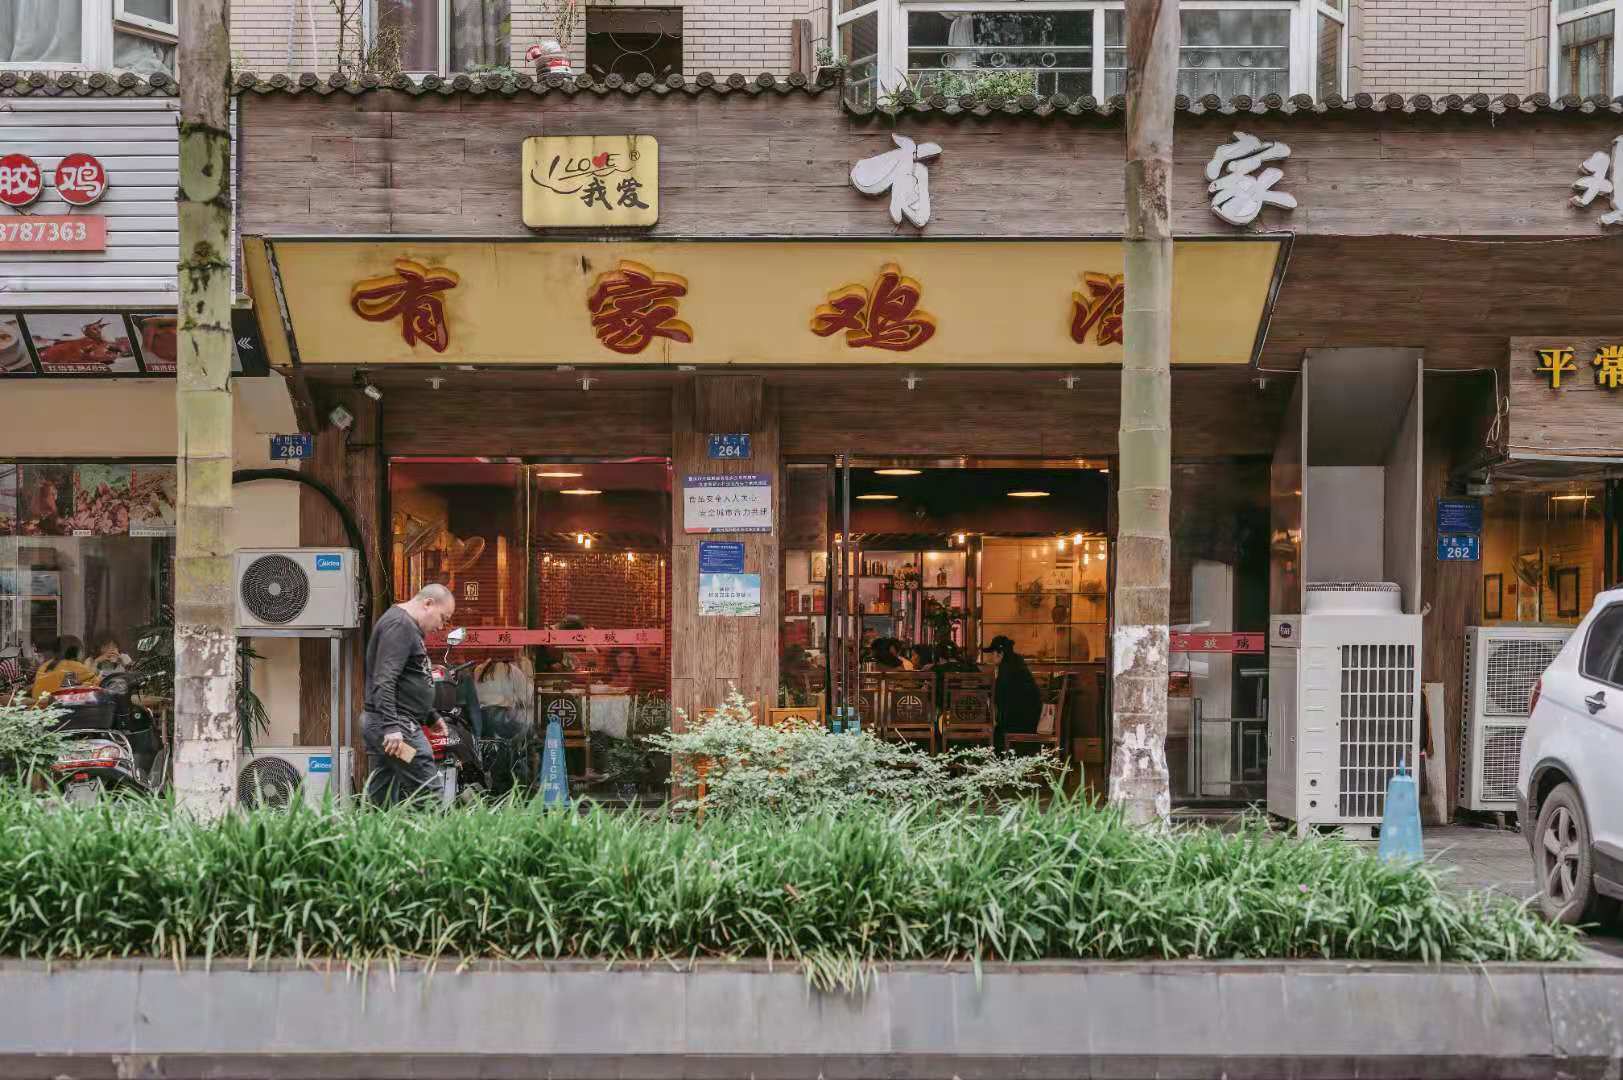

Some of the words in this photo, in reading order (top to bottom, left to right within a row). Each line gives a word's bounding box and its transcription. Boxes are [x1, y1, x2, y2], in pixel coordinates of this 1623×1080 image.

[580, 177, 650, 210] 我爱
[718, 446, 740, 456] 264
[1447, 547, 1470, 558] 262
